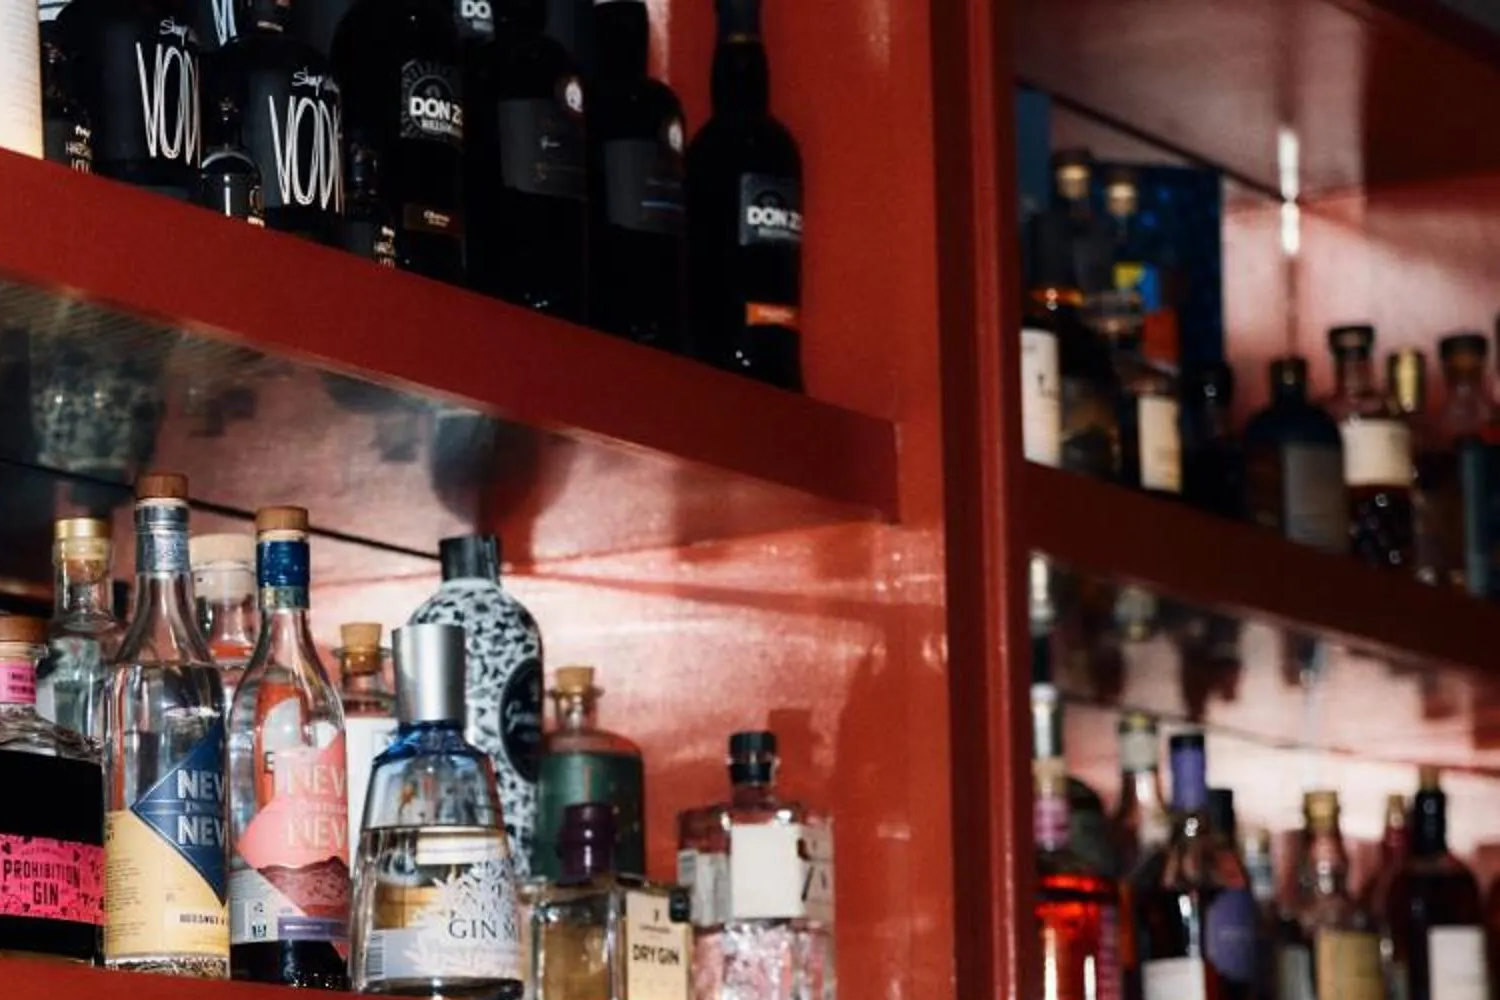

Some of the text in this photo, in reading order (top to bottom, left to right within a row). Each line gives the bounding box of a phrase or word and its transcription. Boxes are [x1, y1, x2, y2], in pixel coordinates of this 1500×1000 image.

[409, 97, 451, 120] DON
[746, 205, 789, 226] DON
[3, 859, 81, 887] PROHIBITION
[33, 881, 59, 906] GIN
[448, 919, 497, 939] GIN
[632, 943, 680, 965] DRY GIN
